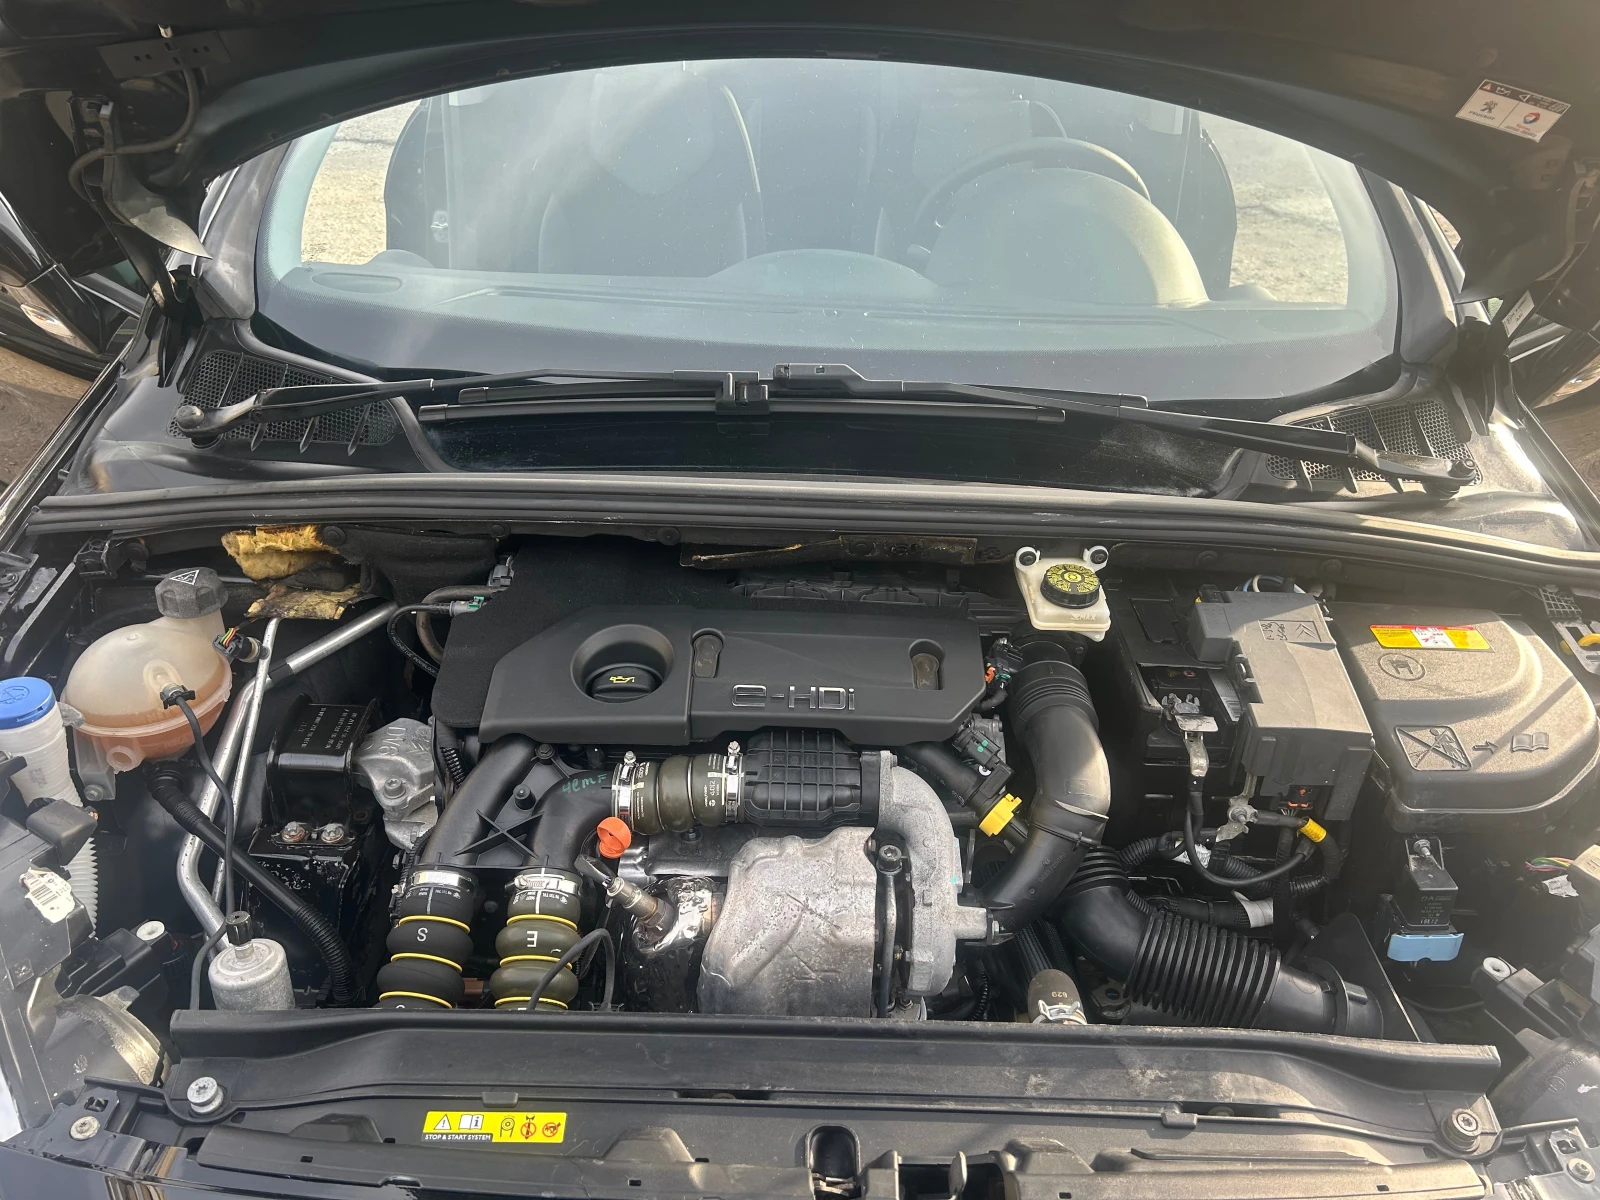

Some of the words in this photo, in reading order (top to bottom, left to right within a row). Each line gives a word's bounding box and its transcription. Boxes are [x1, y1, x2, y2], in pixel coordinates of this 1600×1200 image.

[1469, 110, 1495, 121] PEUGEOT
[1516, 123, 1531, 132] TOTAL
[1079, 613, 1096, 621] MAX
[416, 927, 428, 942] S
[526, 930, 538, 948] E
